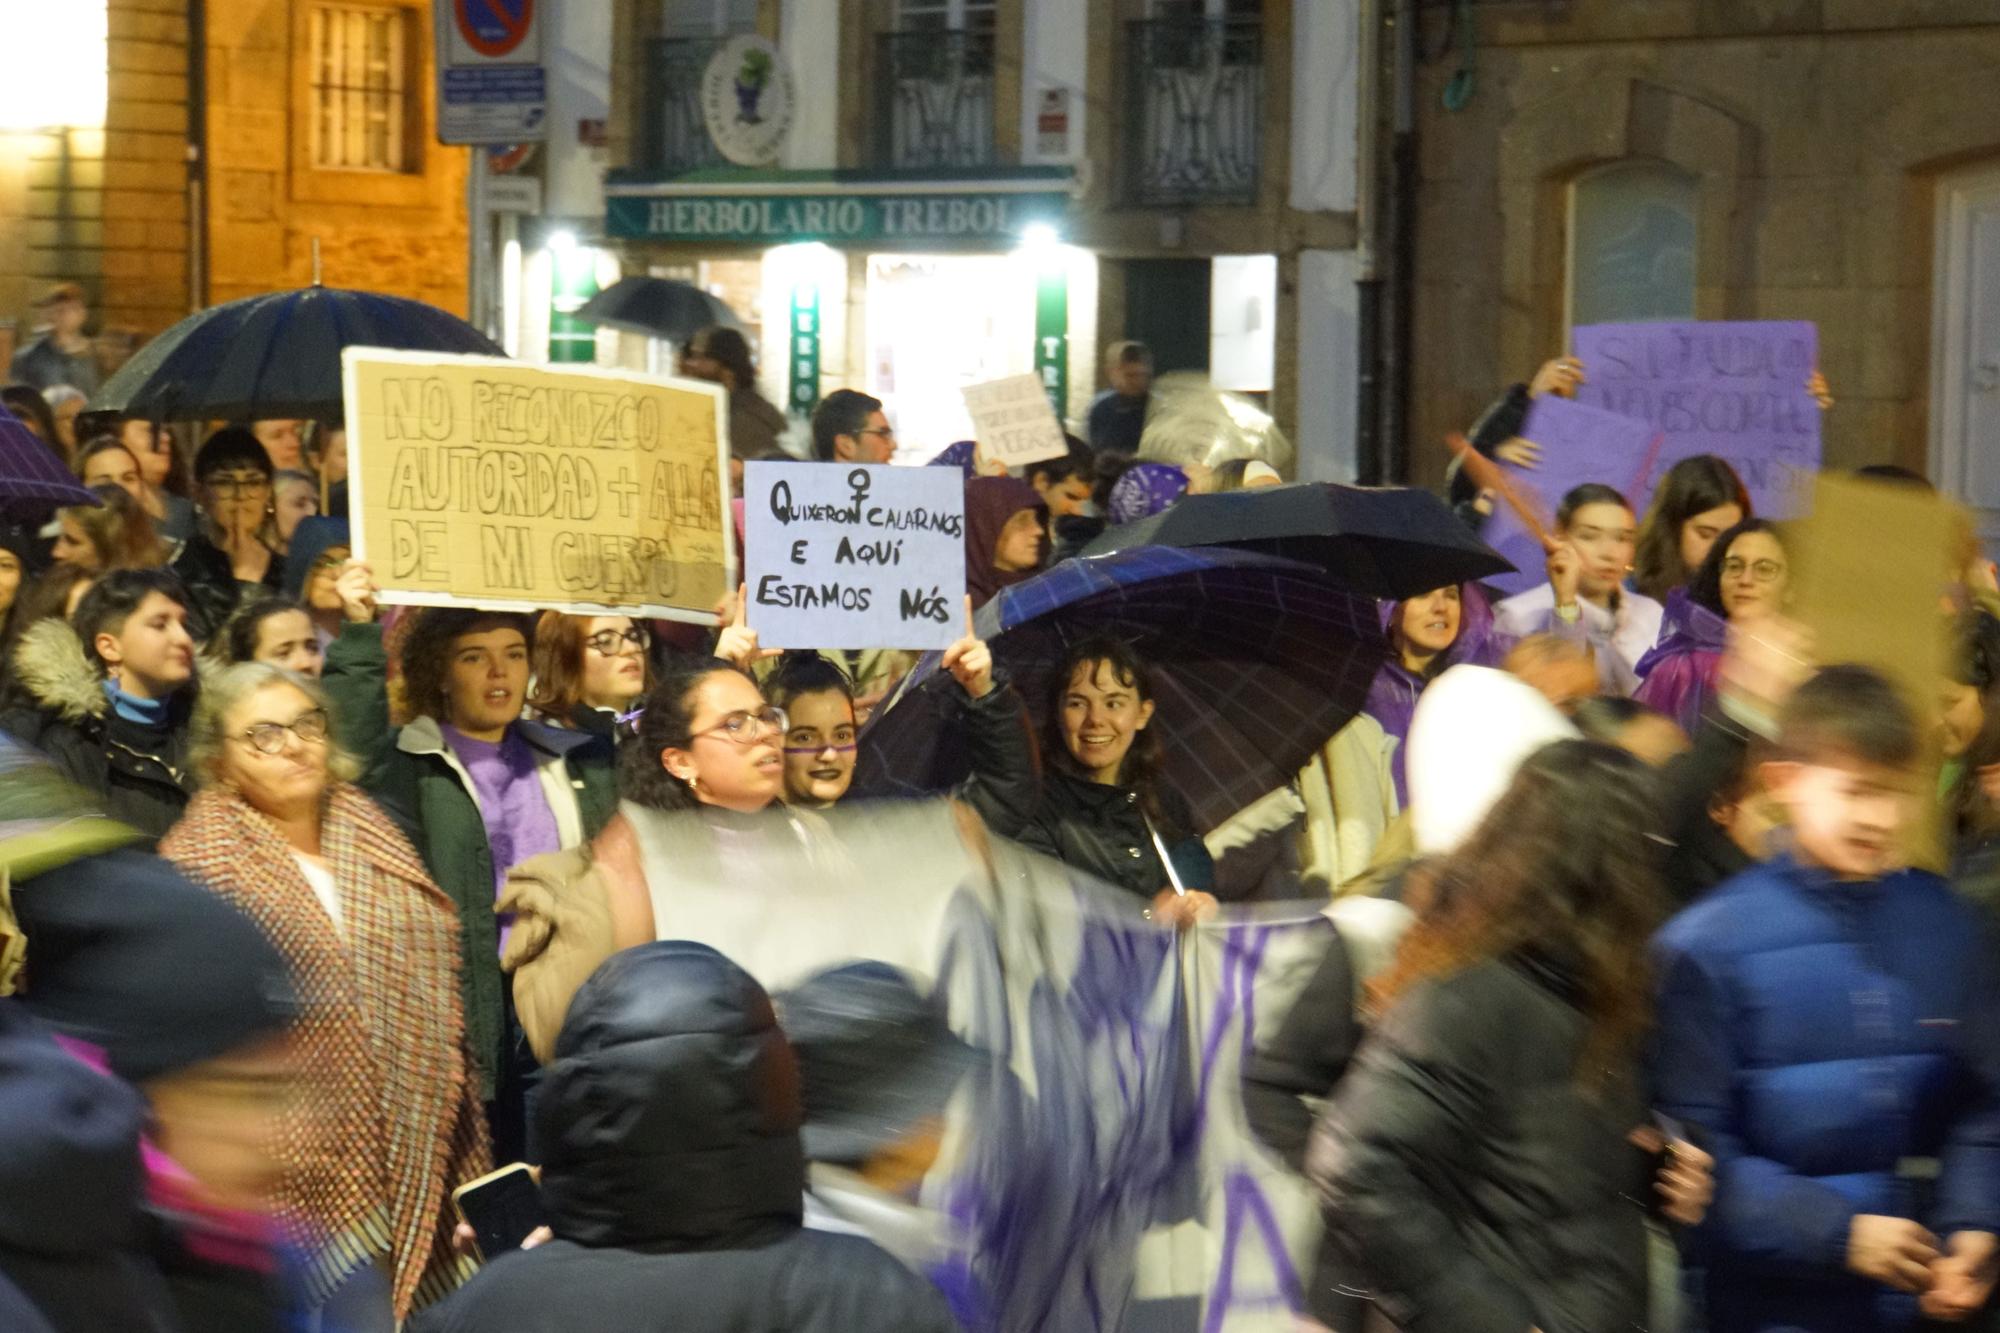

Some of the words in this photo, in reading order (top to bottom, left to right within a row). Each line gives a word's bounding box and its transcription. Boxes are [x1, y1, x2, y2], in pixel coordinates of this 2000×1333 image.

[649, 200, 864, 235] HERBOLARIO
[880, 199, 1010, 235] TREBOL
[383, 377, 453, 441] NO
[471, 380, 661, 453] RECONOZCO
[388, 446, 599, 520] AUTORIDAD
[770, 479, 861, 525] QUIXERON
[866, 506, 964, 538] CALARNOS
[391, 519, 451, 583] DE
[481, 524, 534, 591] MI
[550, 531, 678, 599] CUERPO
[790, 539, 809, 565] E
[834, 536, 904, 566] AQUÍ
[755, 574, 873, 612] ESTAMOS
[900, 585, 951, 624] NÓS
